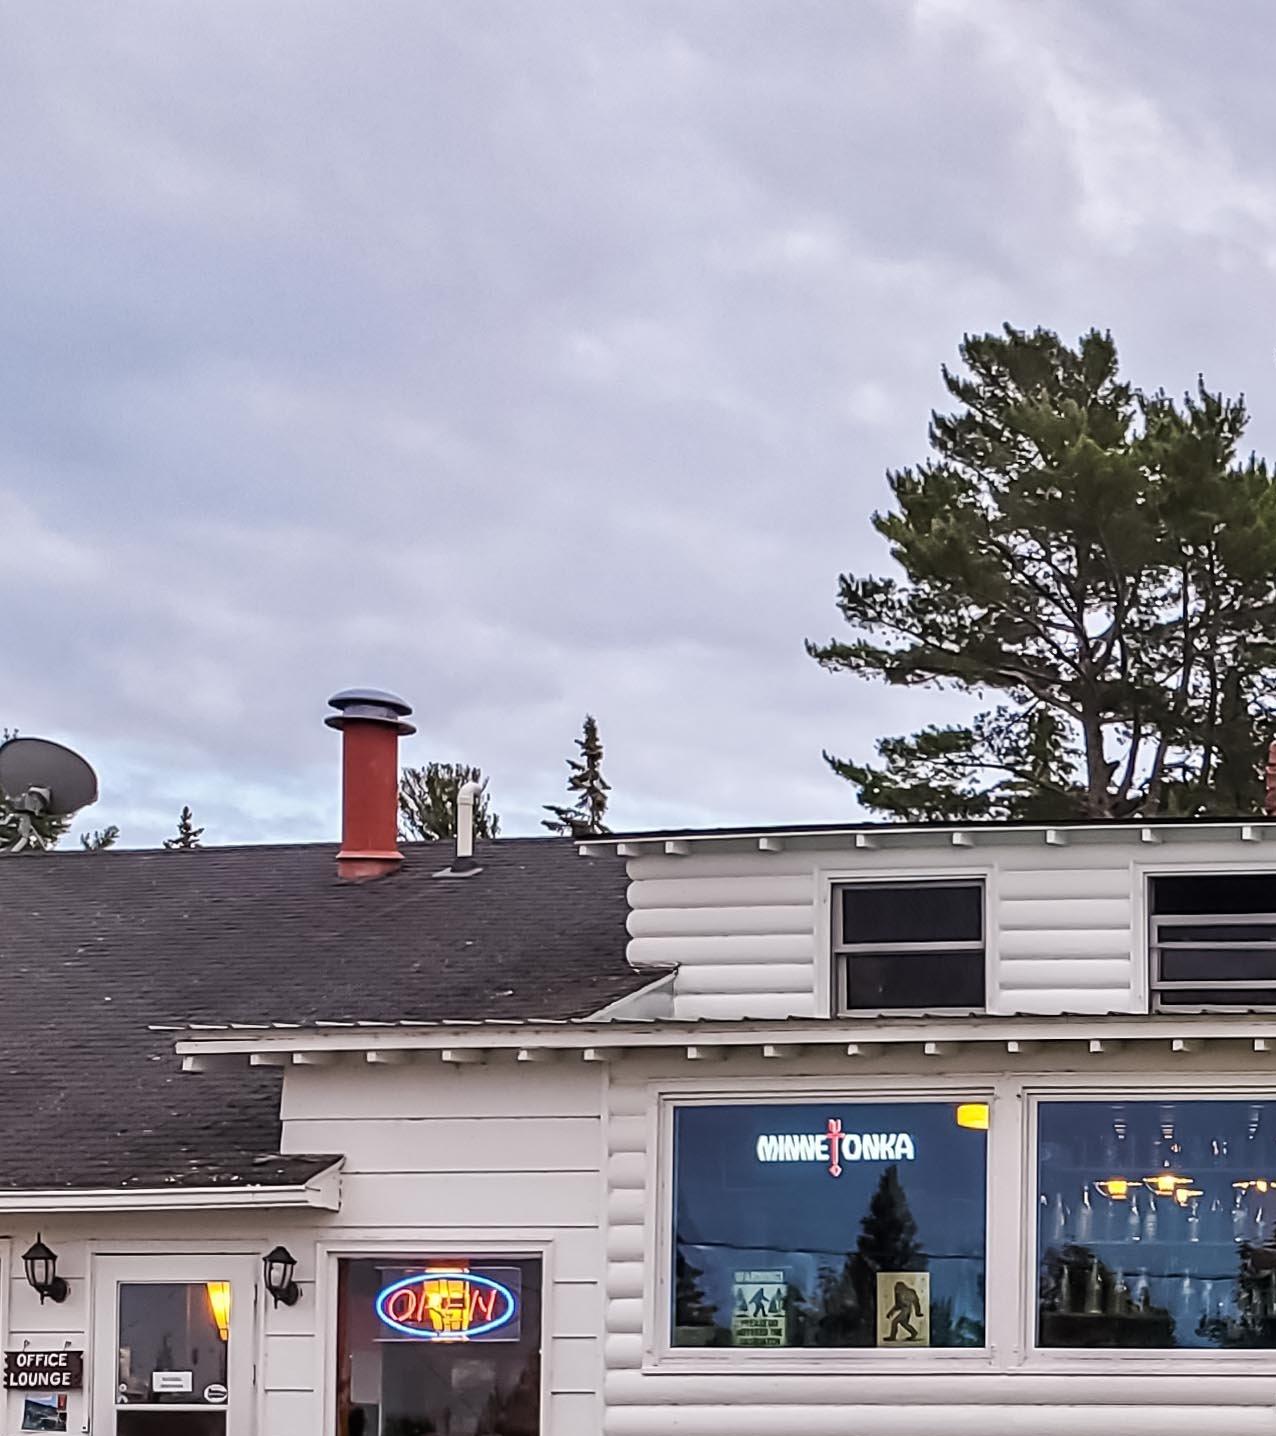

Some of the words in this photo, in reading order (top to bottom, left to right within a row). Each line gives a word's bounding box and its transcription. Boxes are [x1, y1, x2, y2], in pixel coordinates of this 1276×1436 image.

[756, 1119, 915, 1177] MINNETONKA
[16, 1353, 68, 1367] OFFICE
[9, 1371, 72, 1387] LOUNGE
